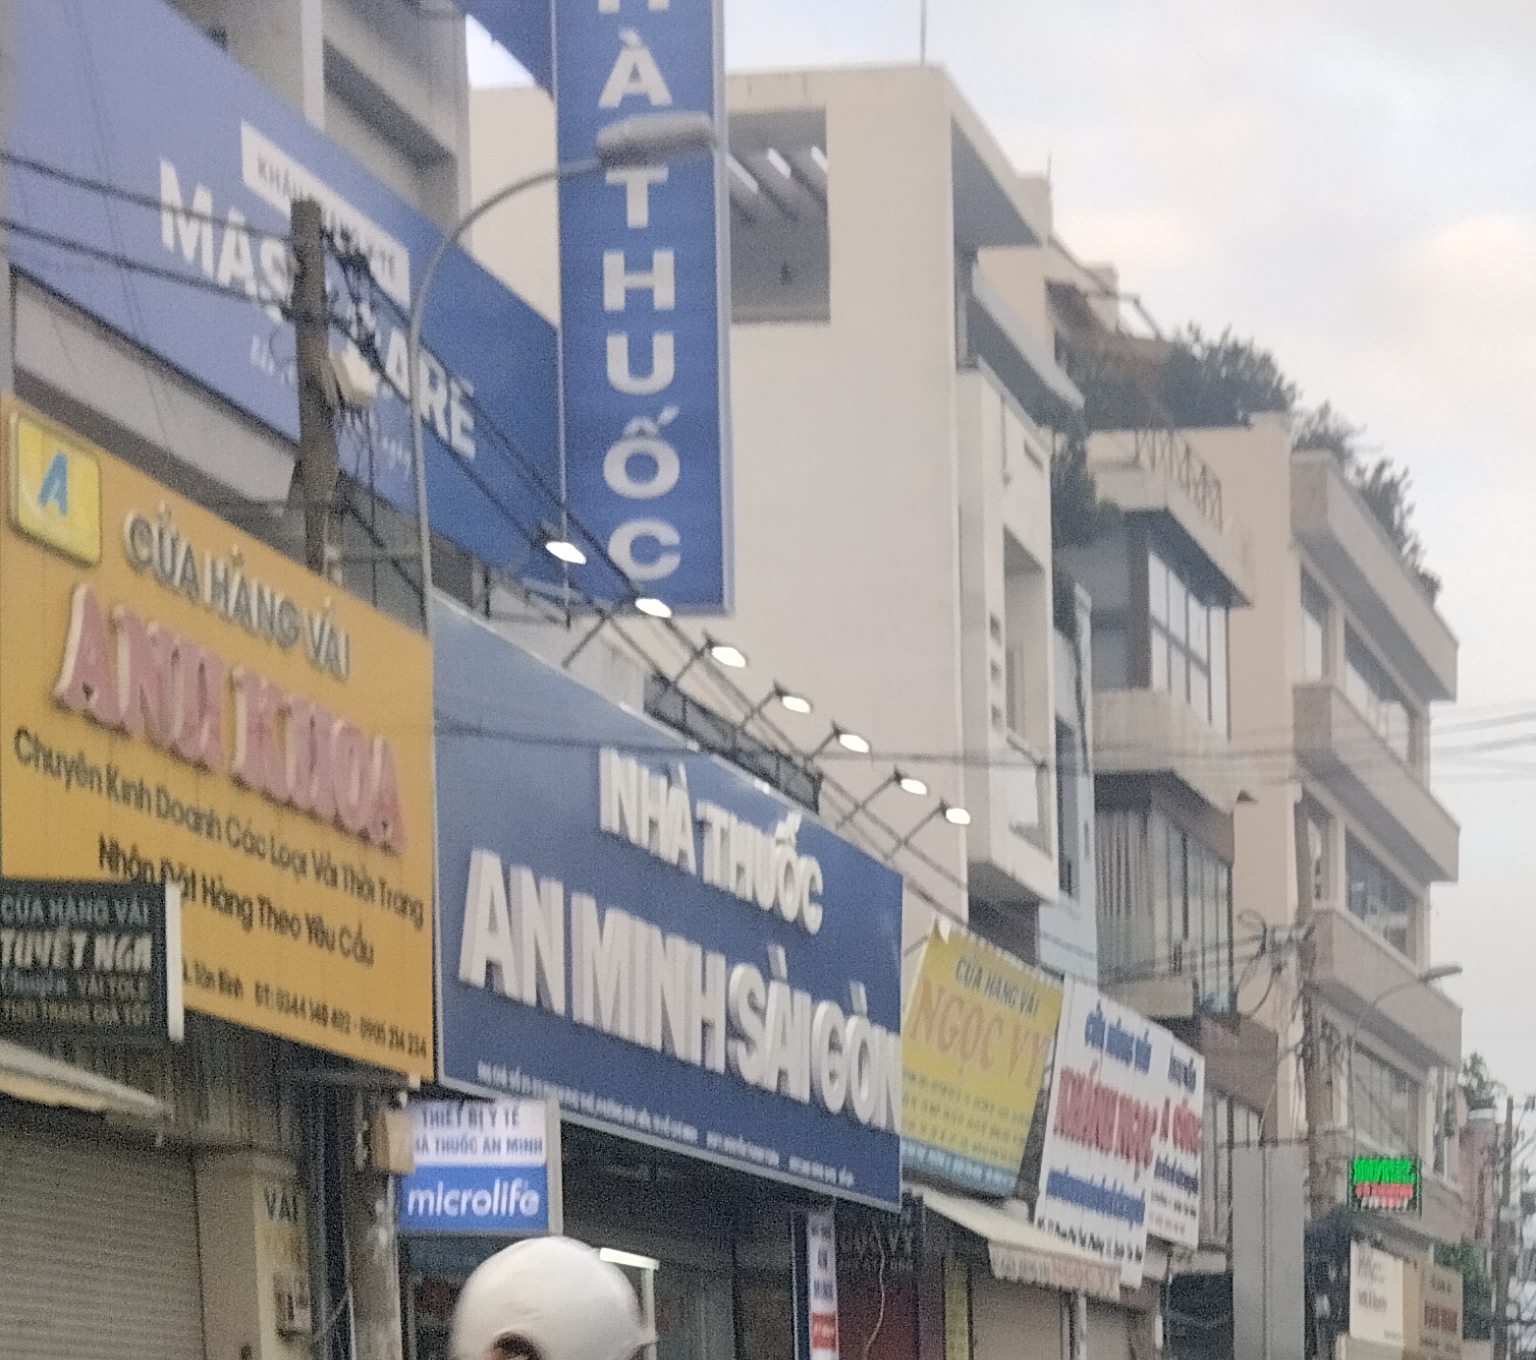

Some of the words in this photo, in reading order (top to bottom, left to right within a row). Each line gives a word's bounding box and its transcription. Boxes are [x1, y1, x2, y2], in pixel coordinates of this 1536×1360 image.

[203, 543, 299, 654] HÀNG
[13, 726, 103, 793] Chuyên
[106, 761, 153, 814] Kinh
[600, 746, 698, 876] NHÀ
[697, 808, 825, 936] THUỐC
[257, 892, 302, 942] Theo
[458, 848, 567, 1018] AN
[570, 891, 727, 1076] MINH
[727, 944, 812, 1106] SÀI
[811, 980, 902, 1138] GÒN
[407, 1177, 540, 1218] microlife
